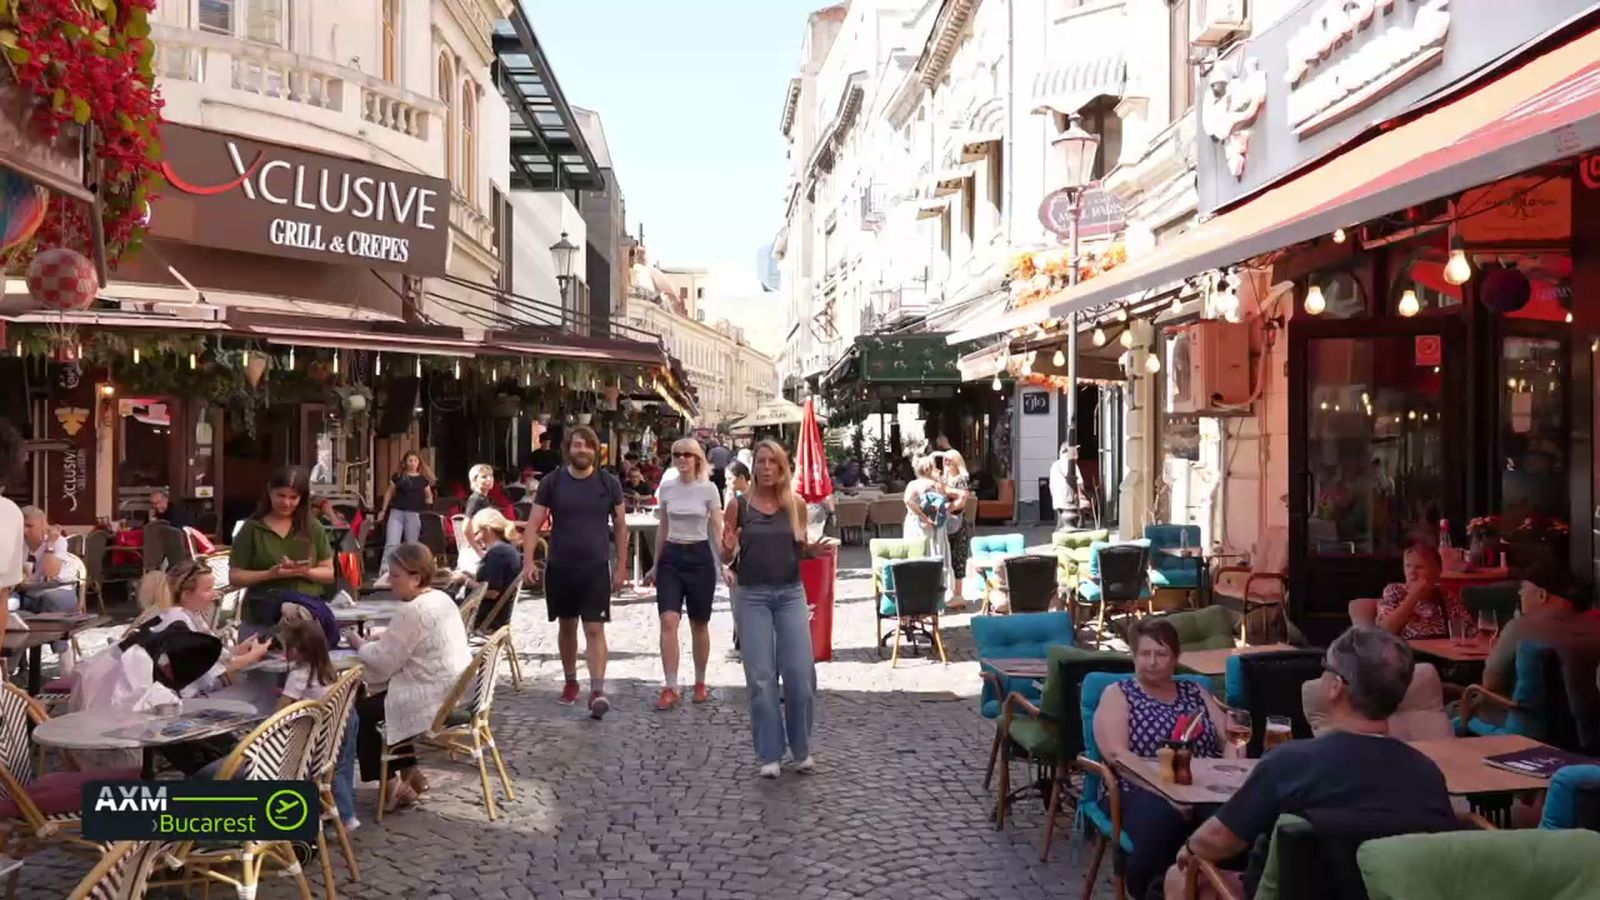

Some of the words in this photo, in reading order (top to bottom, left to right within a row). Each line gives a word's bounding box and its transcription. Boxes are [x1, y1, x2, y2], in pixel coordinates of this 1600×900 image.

[162, 142, 438, 230] XCLUSIVE
[270, 218, 325, 251] GRILL
[329, 235, 345, 254] &
[347, 230, 410, 263] CREPES
